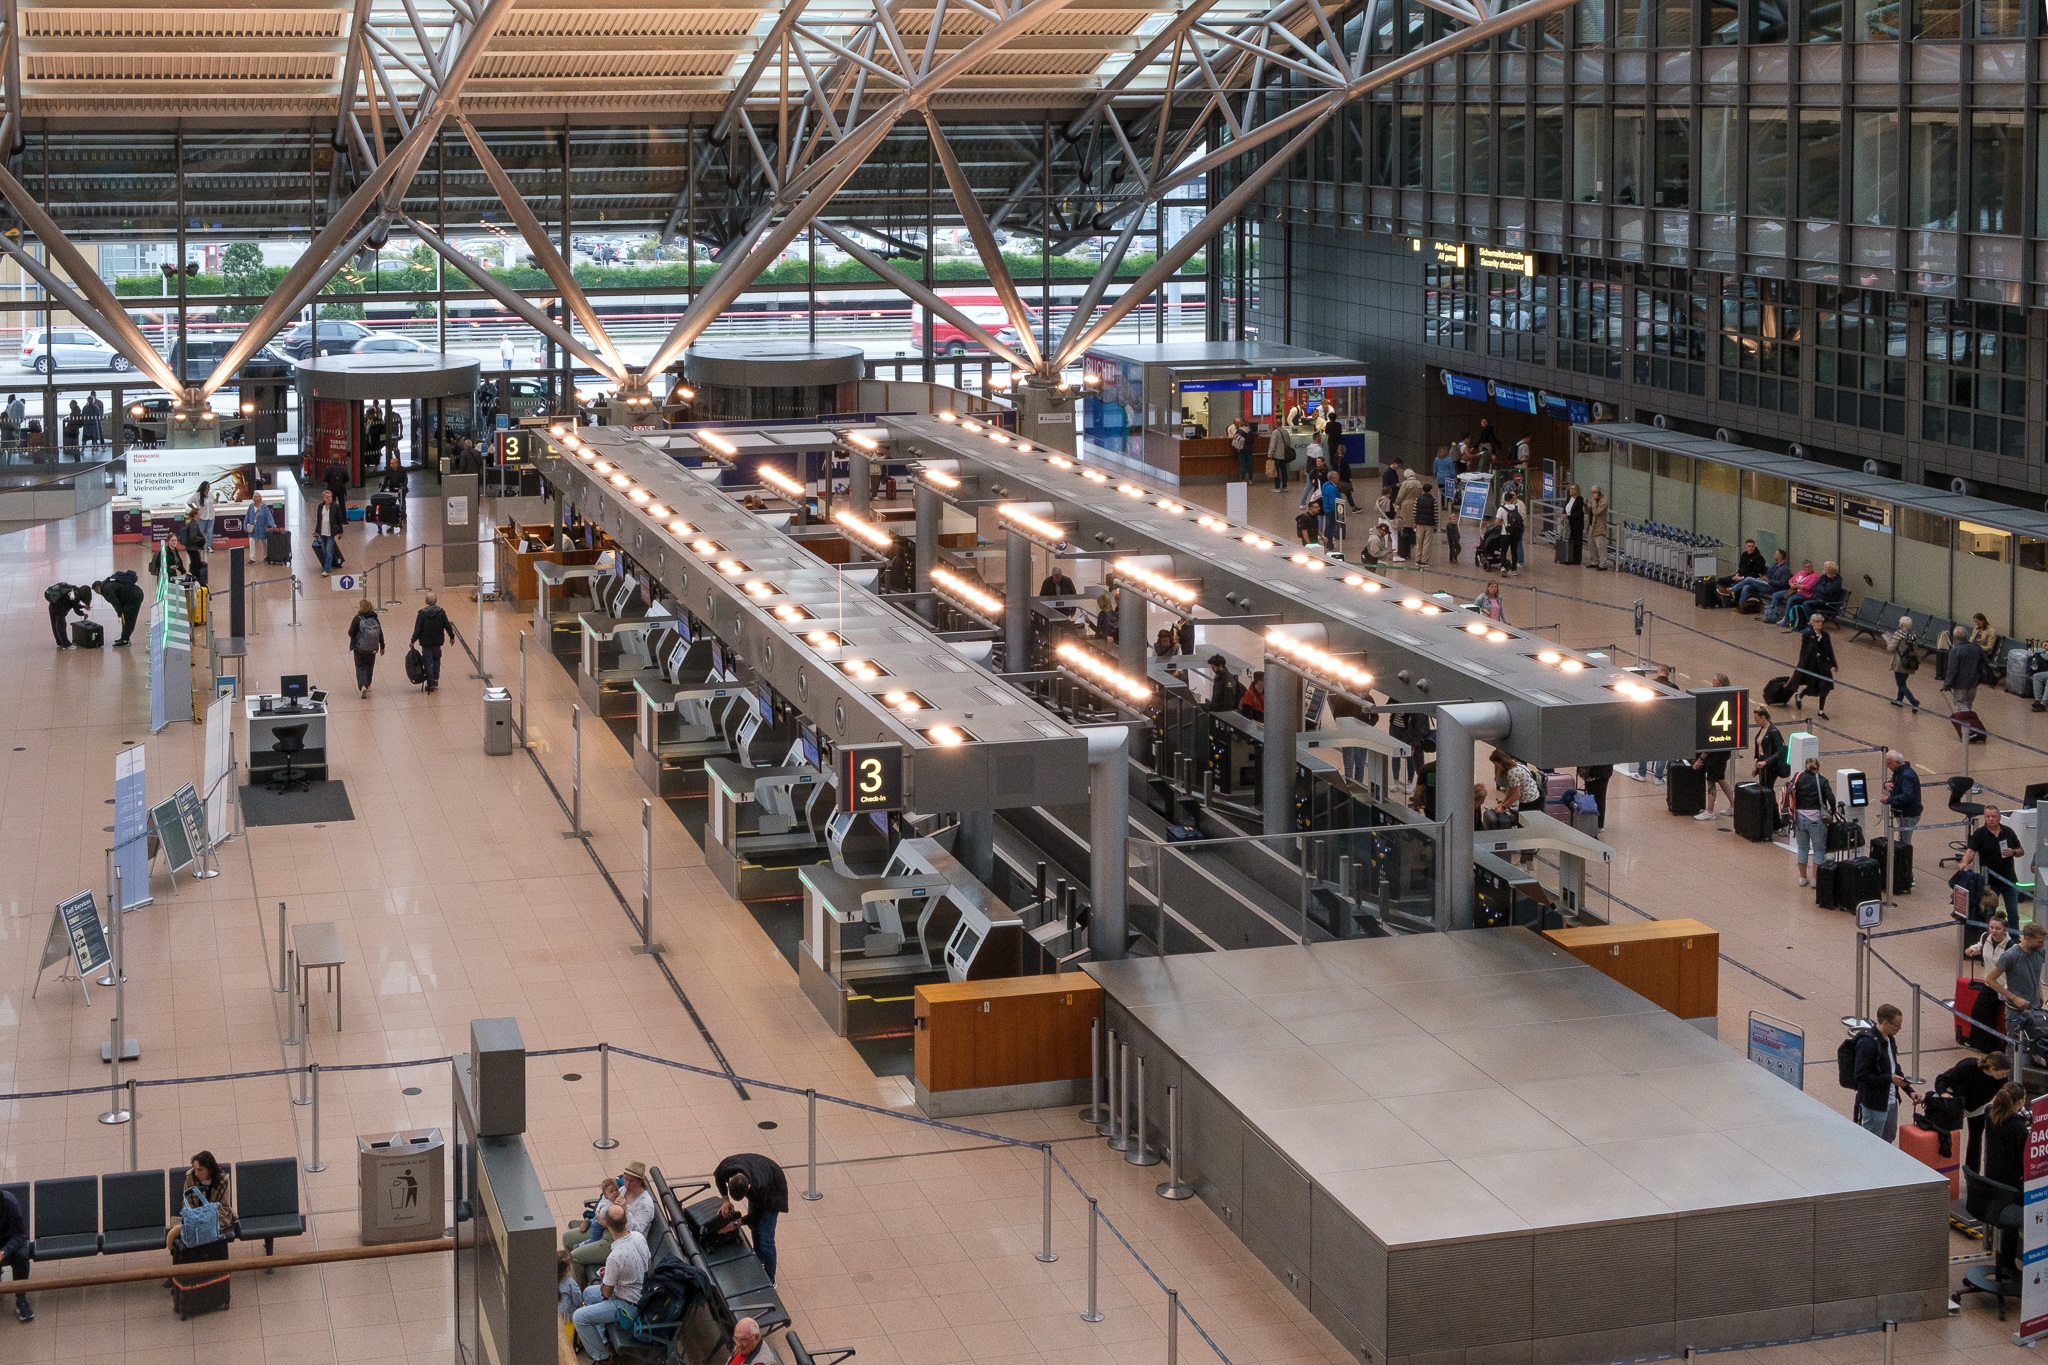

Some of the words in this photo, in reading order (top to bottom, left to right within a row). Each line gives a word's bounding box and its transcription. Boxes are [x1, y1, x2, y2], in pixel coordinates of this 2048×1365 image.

[1444, 243, 1456, 252] Gates
[1445, 254, 1456, 262] gates
[1480, 258, 1499, 269] Security
[1500, 260, 1524, 271] checkpoint
[1086, 357, 1115, 382] BUCHT!
[506, 437, 518, 456] 3
[1711, 700, 1732, 732] 4
[860, 758, 882, 792] 3
[861, 795, 886, 803] Check-in
[66, 906, 75, 915] Self
[74, 899, 92, 910] Services
